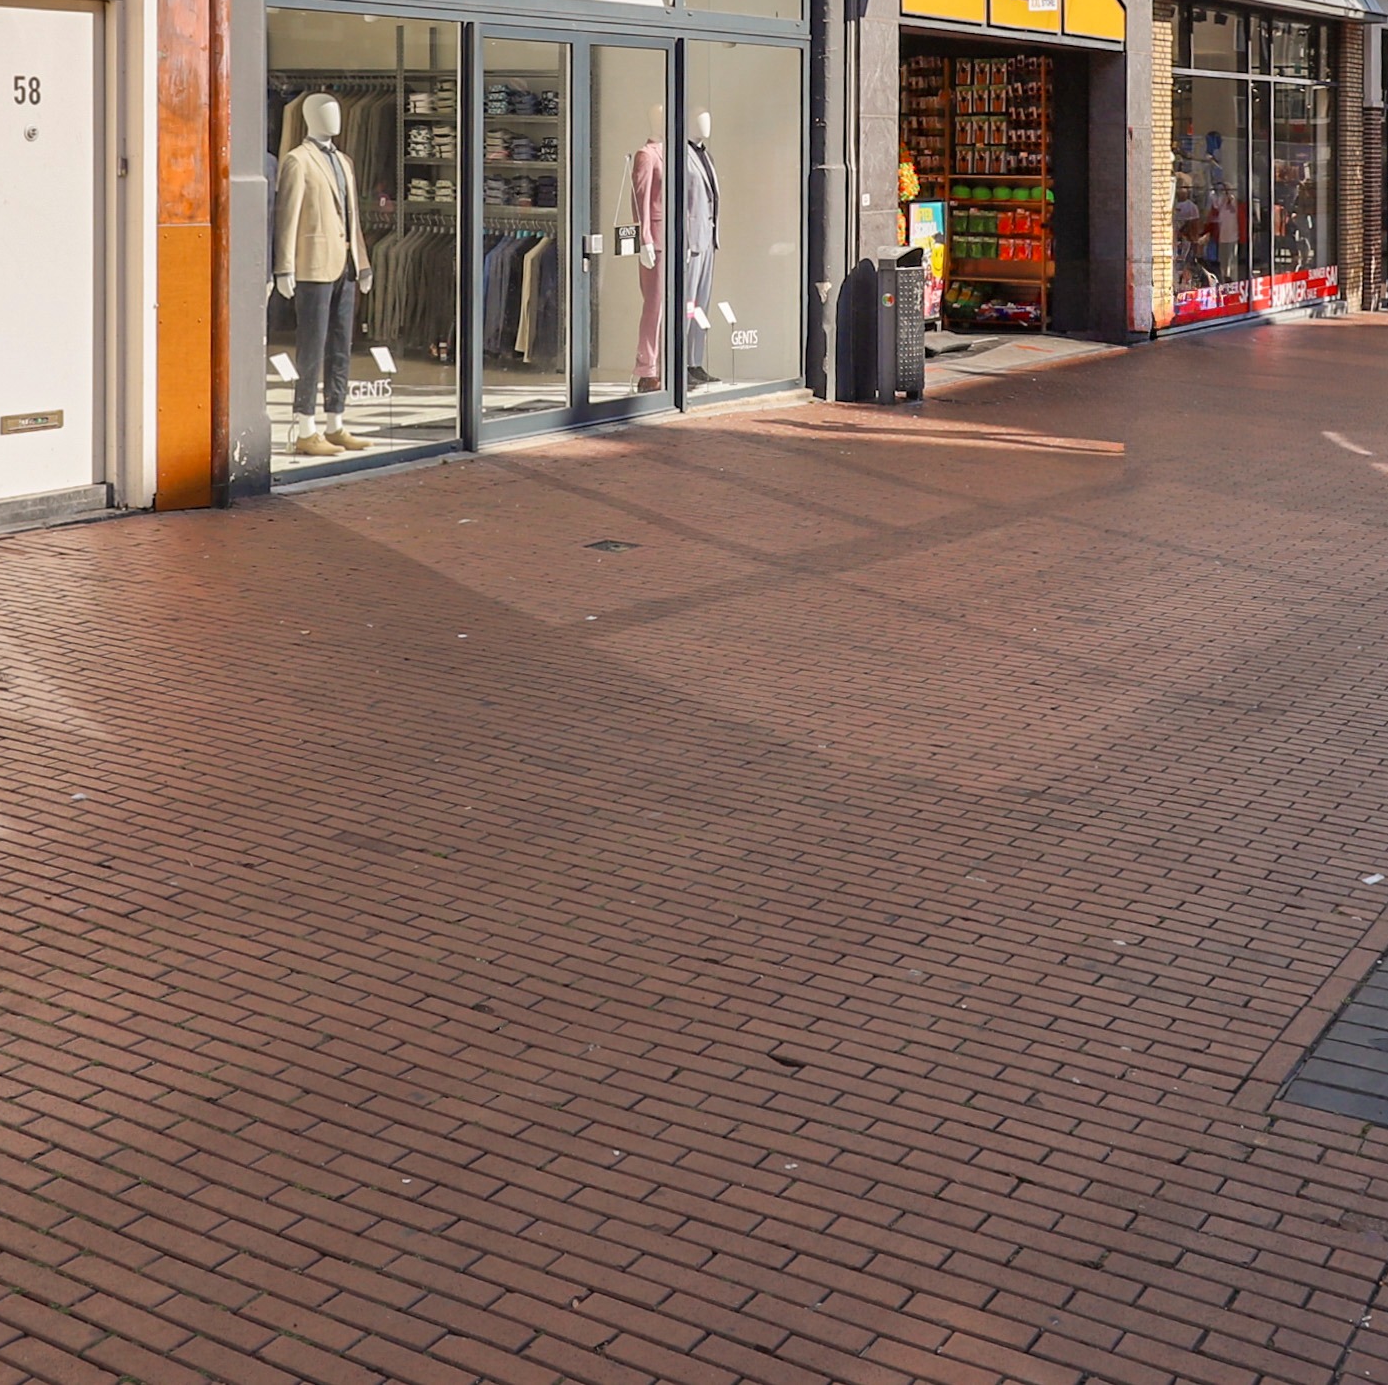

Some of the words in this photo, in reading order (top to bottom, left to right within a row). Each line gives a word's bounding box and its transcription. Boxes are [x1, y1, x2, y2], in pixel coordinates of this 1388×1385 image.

[14, 76, 41, 105] 58
[731, 329, 758, 345] GENTS
[349, 378, 392, 400] GENTS
